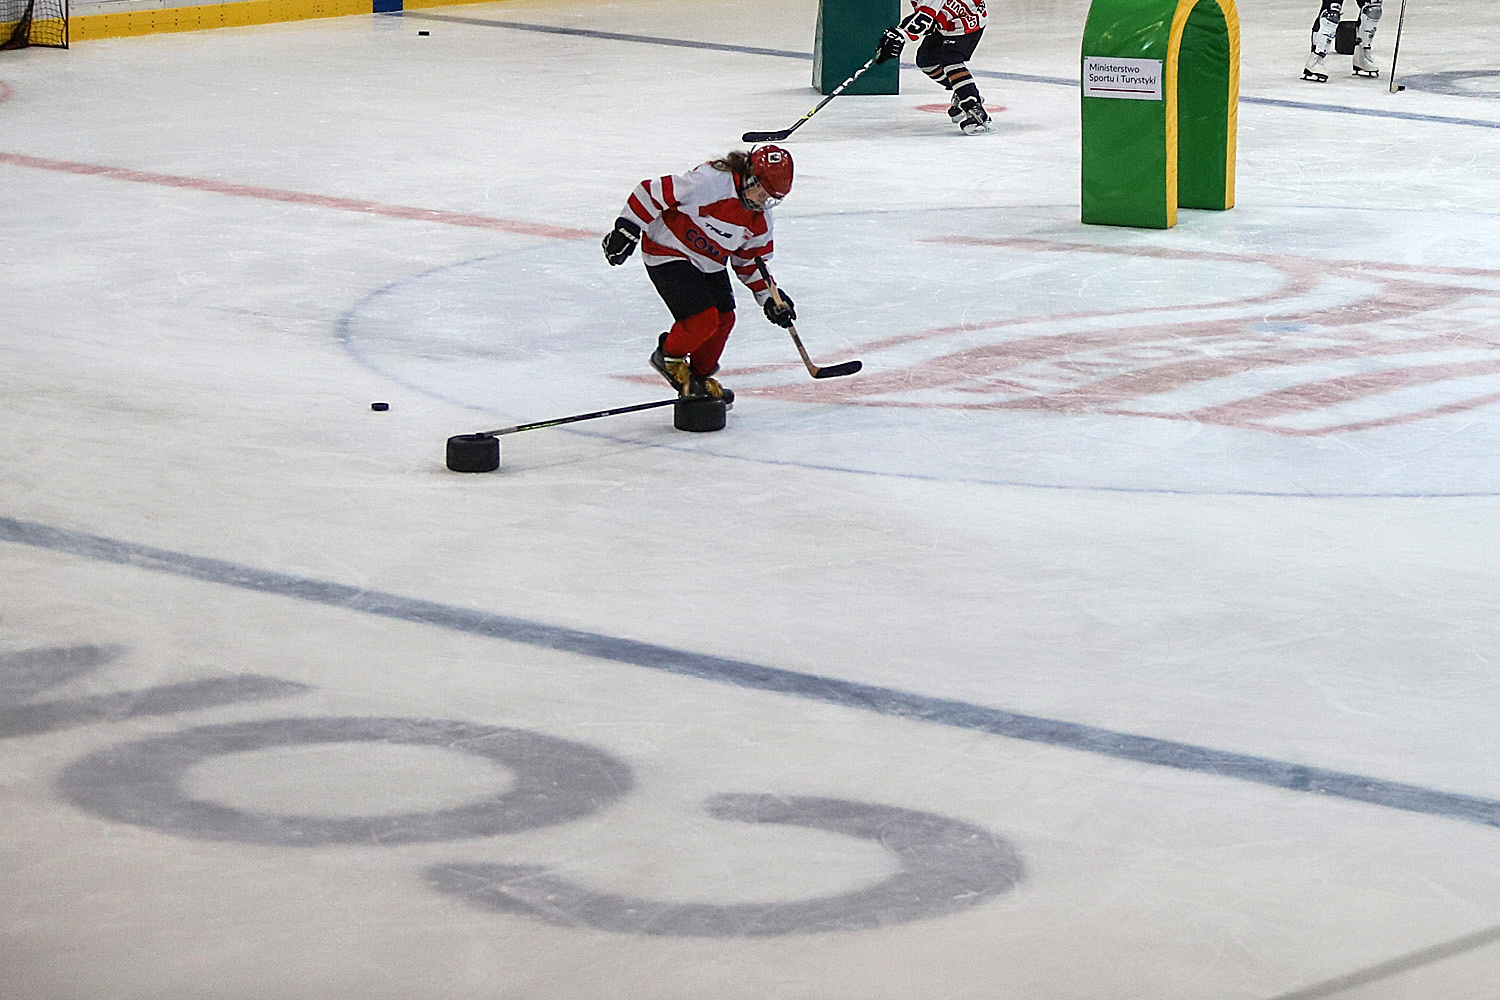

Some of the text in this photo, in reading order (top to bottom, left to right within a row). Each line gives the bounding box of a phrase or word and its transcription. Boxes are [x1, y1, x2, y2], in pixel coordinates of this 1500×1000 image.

[1089, 63, 1140, 74] Ministerstwo
[1089, 73, 1115, 83] Sportu
[1121, 75, 1157, 85] Turystyki
